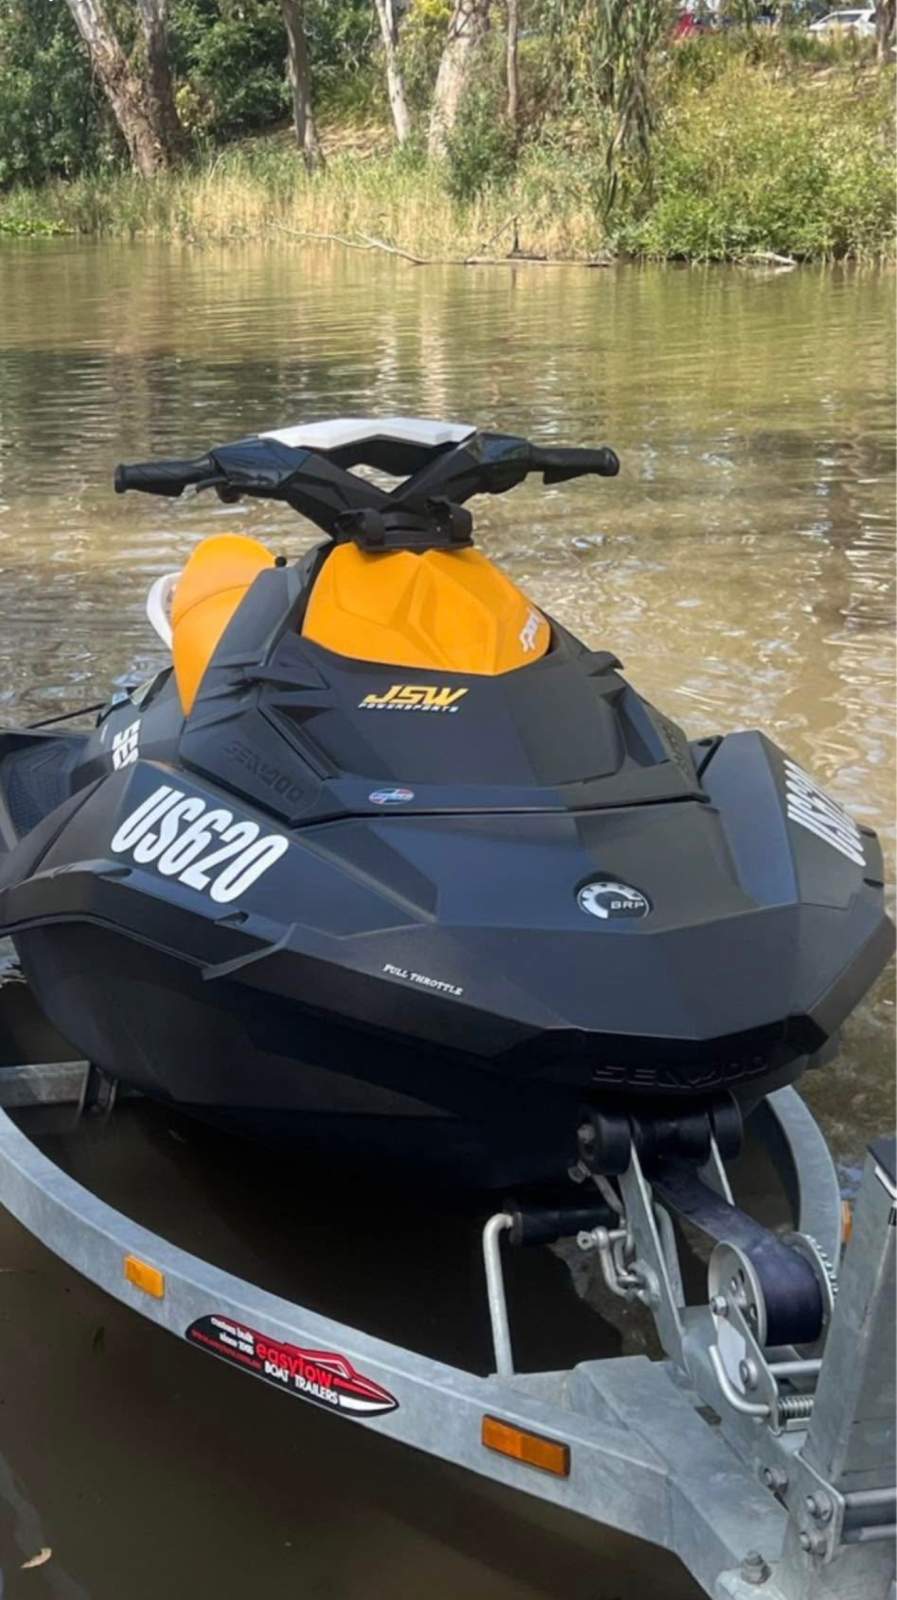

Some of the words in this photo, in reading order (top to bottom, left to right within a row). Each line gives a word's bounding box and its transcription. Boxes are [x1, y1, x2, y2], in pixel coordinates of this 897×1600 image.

[358, 702, 459, 713] POWERSPORTS
[362, 685, 469, 706] JSW
[111, 785, 289, 904] US620
[610, 900, 645, 911] BRP
[383, 963, 408, 979] FULL
[409, 971, 464, 996] THROTTLE
[264, 1361, 289, 1382] BOAT
[295, 1374, 339, 1405] TRAILERS
